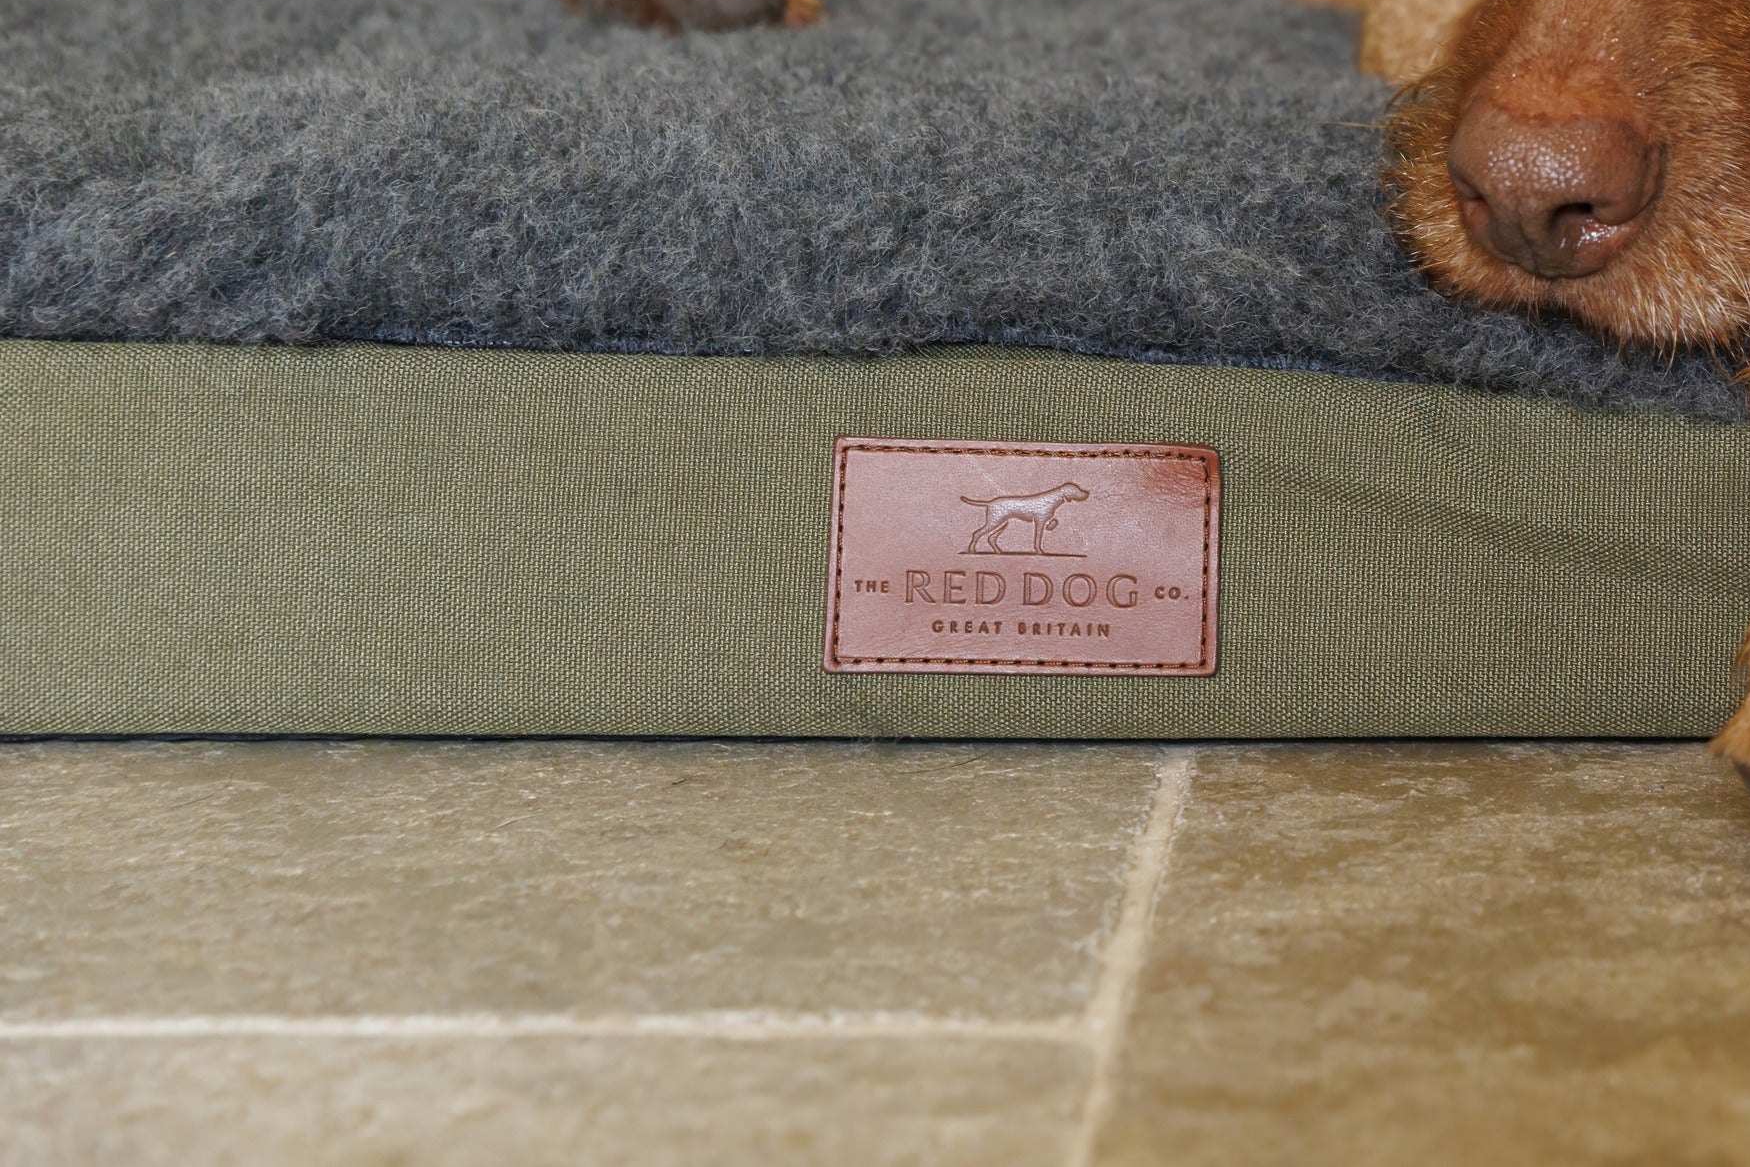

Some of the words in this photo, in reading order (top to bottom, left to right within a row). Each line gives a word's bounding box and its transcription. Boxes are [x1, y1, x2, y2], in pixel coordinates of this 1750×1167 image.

[854, 579, 890, 594] THE
[904, 570, 1007, 607] RED
[1022, 572, 1139, 609] DOG
[1154, 586, 1190, 601] CO.
[931, 619, 1003, 635] GREAT
[1018, 622, 1110, 638] BRITAIN
